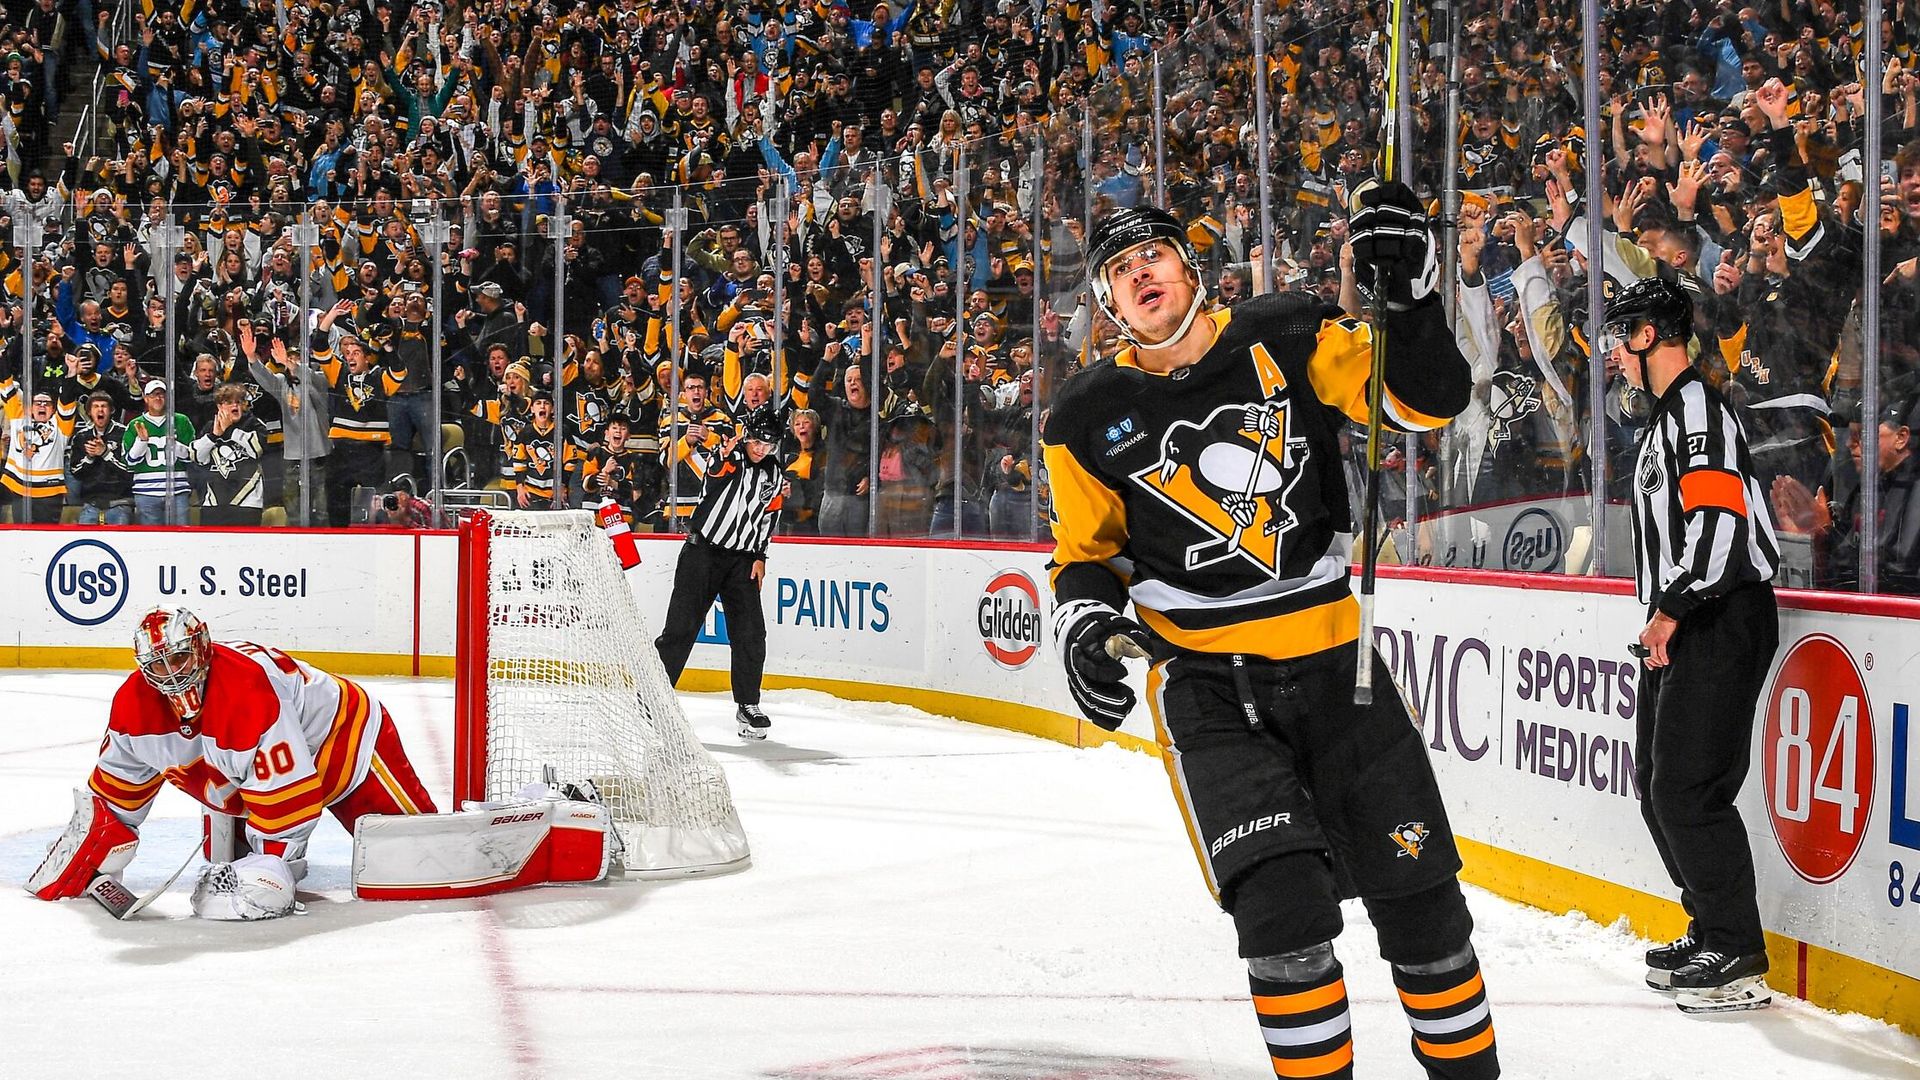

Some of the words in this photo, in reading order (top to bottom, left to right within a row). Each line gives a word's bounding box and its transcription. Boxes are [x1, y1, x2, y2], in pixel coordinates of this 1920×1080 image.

[1249, 341, 1287, 400] A
[1687, 434, 1708, 455] 27
[604, 512, 622, 525] BIO
[159, 565, 187, 595] U.
[199, 566, 226, 596] S.
[238, 566, 307, 598] Steel
[777, 577, 890, 633] PAINTS
[978, 596, 1041, 643] Glidden
[1374, 625, 1491, 762] PMC
[1516, 647, 1636, 721] SPORTS
[254, 740, 295, 781] 80
[1515, 718, 1642, 801] MEDICIN
[1774, 686, 1860, 835] 84
[490, 811, 546, 826] BAUER
[570, 811, 597, 820] MACH
[110, 842, 137, 855] MACH
[1211, 811, 1292, 858] BAUER
[94, 880, 130, 909] BAUER
[256, 876, 285, 891] MACH
